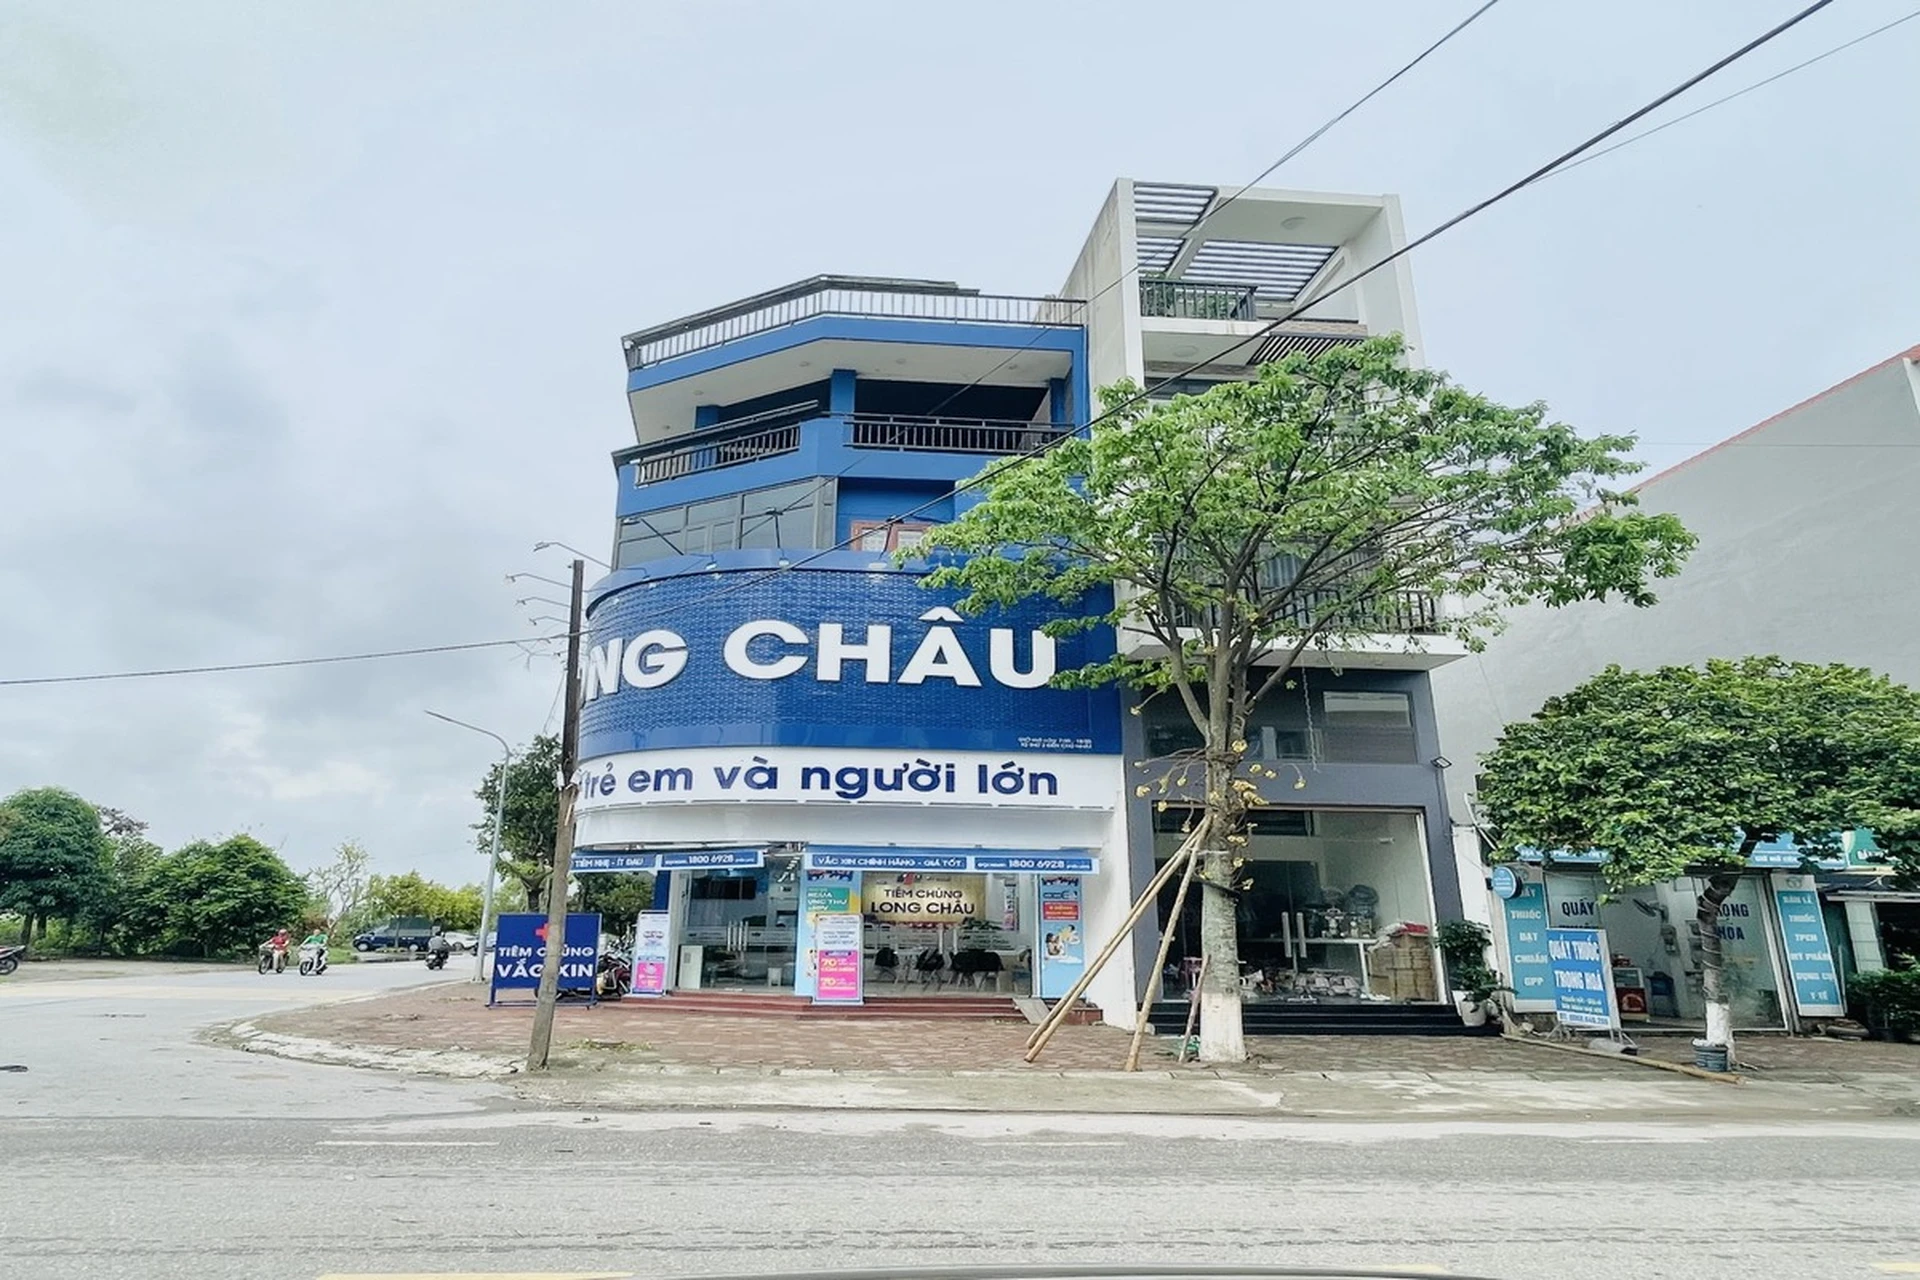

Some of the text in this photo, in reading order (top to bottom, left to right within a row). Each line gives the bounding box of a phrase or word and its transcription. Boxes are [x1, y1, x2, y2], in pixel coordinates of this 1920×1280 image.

[723, 606, 1058, 689] CHÂU
[584, 756, 1058, 799] trẻ em và người lớn
[689, 855, 709, 864] 1800
[710, 854, 734, 863] 6928
[840, 858, 856, 866] XIN
[923, 858, 941, 867] GIÁ
[1008, 859, 1034, 868] 1800
[1036, 859, 1065, 869] 6928
[884, 887, 913, 899] TIÊM
[871, 900, 975, 914] LONG CHÂU
[499, 945, 532, 957] TIÊM
[497, 959, 593, 978] VẮC XIN
